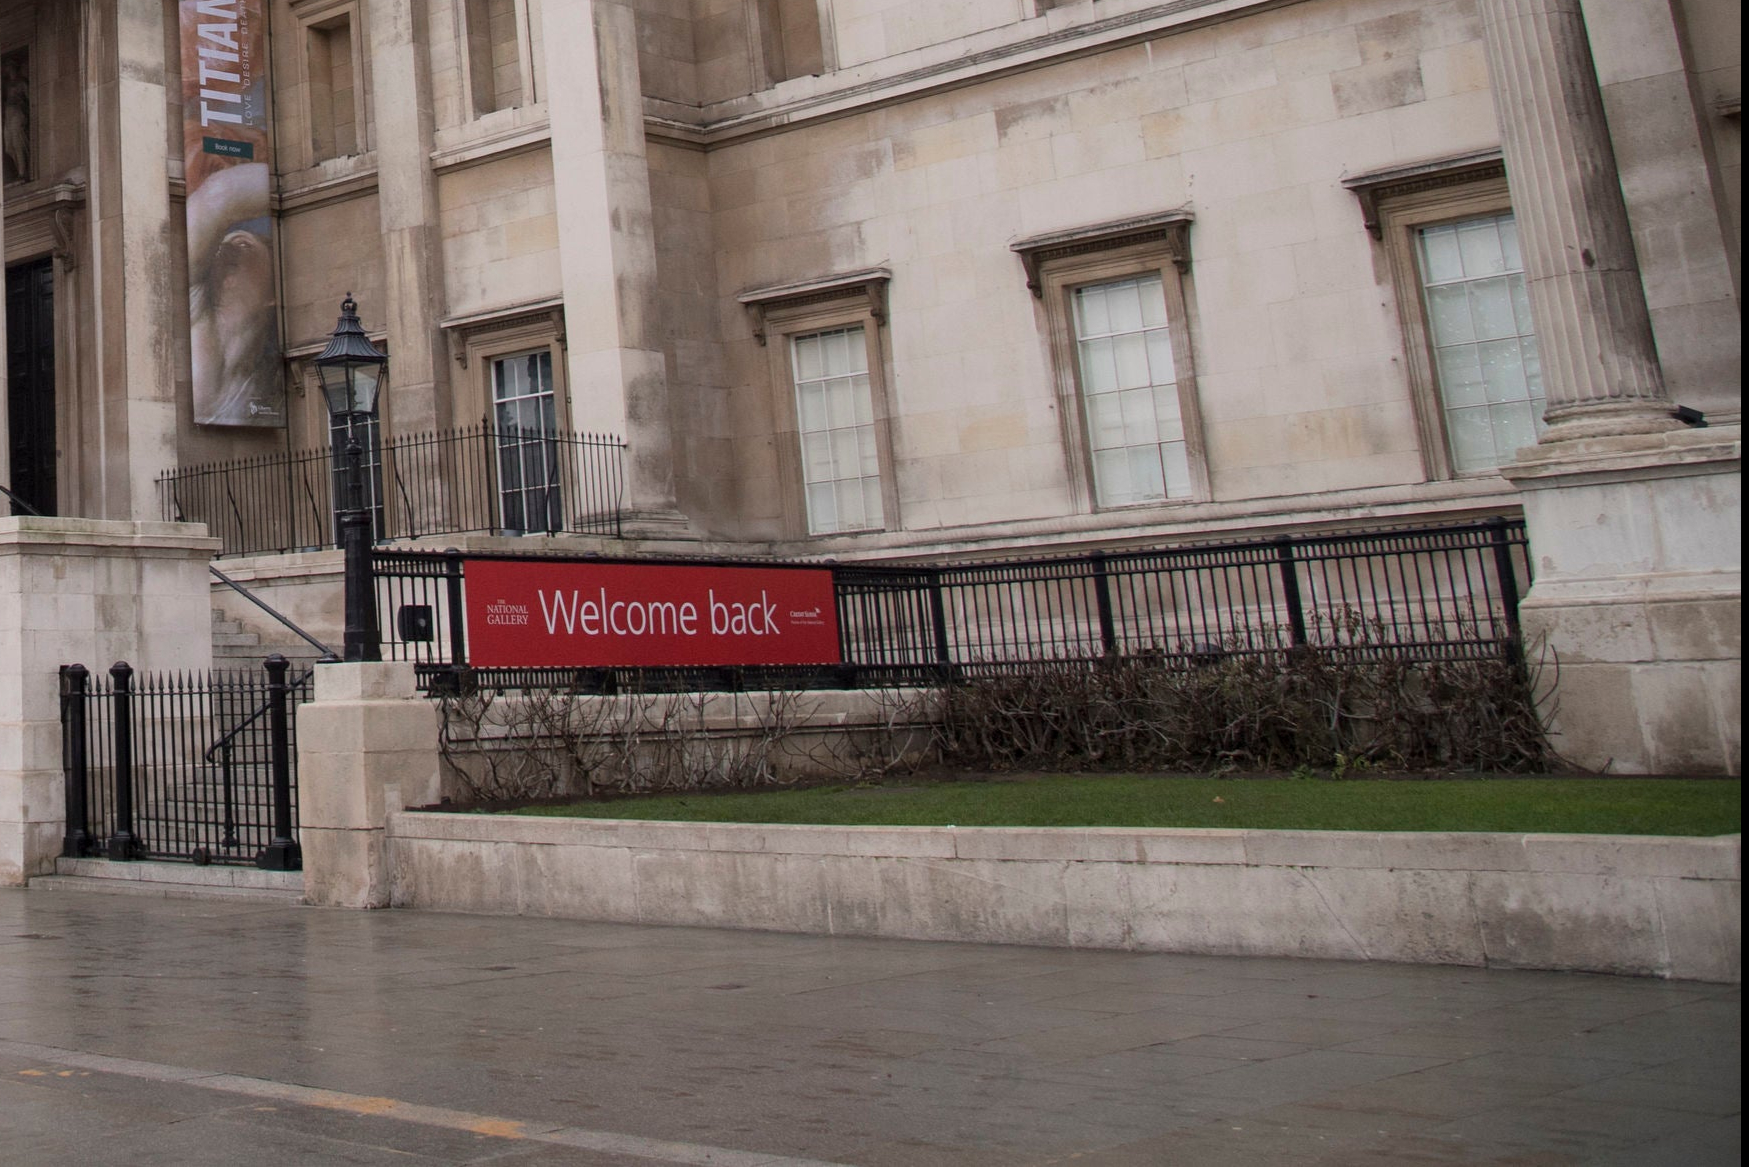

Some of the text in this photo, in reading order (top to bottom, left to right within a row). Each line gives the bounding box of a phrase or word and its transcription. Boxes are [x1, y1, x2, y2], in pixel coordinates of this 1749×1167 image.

[242, 41, 250, 86] DESIRE
[243, 94, 252, 125] LOVE
[486, 604, 529, 614] NATIONAL
[486, 614, 529, 625] GALLERY
[537, 587, 781, 636] Welcome back
